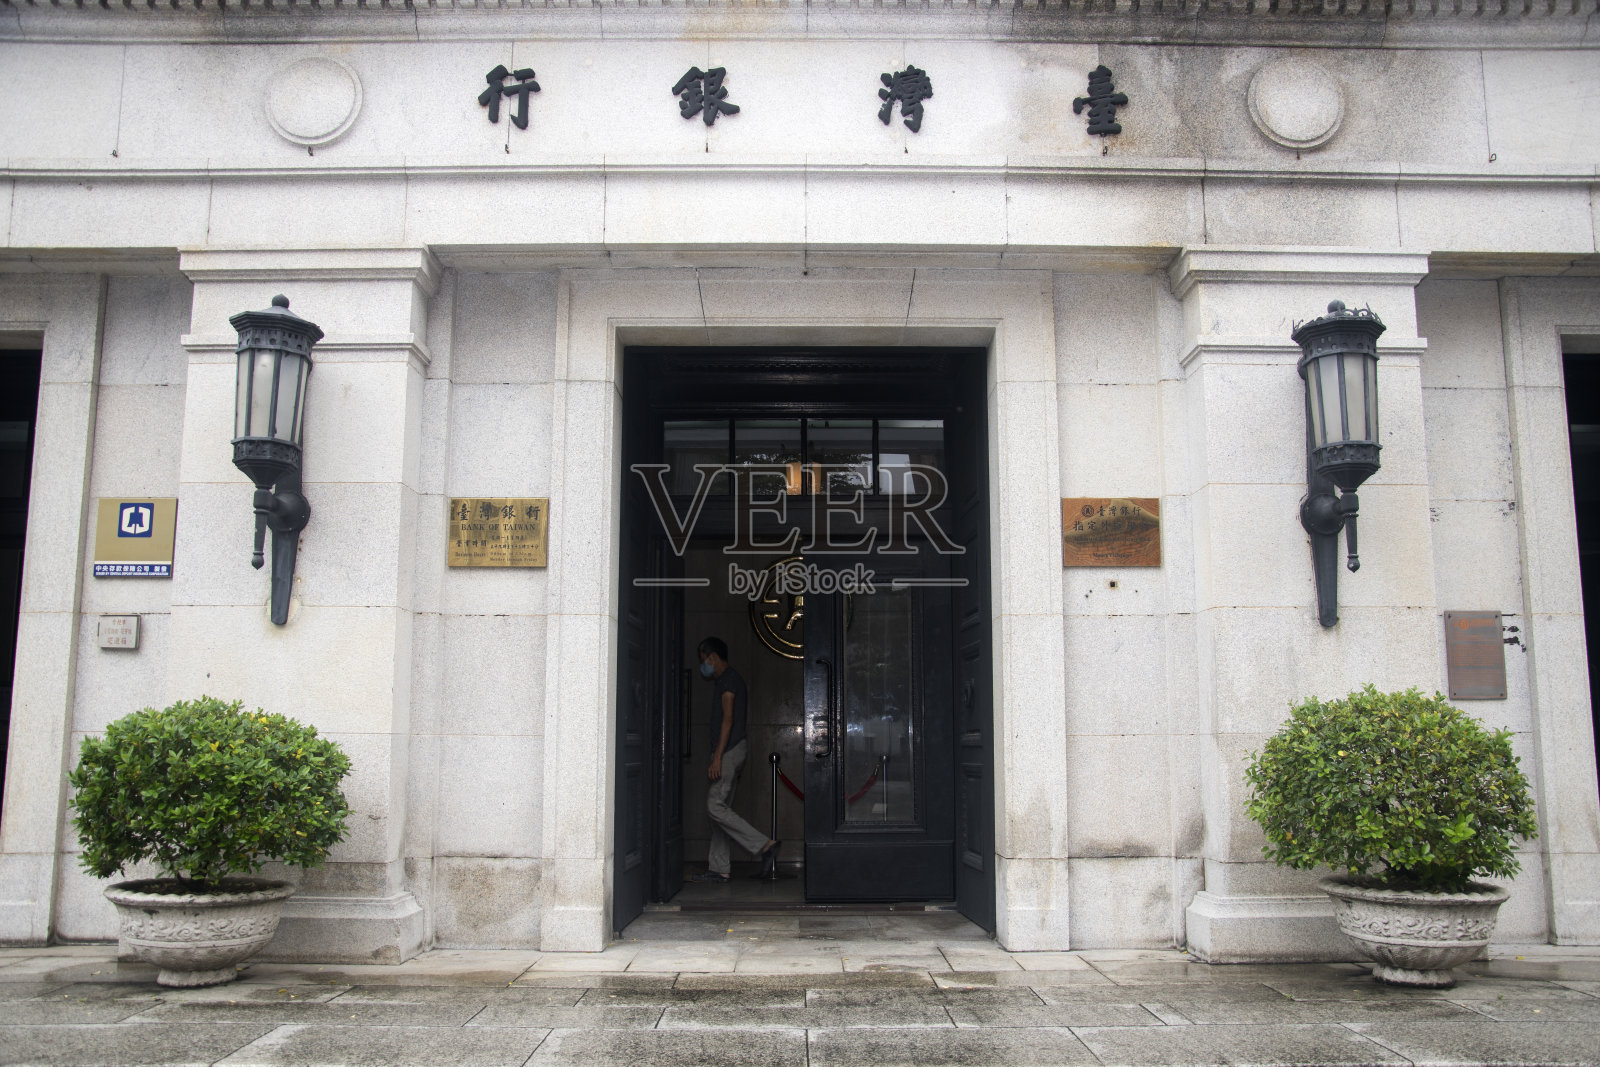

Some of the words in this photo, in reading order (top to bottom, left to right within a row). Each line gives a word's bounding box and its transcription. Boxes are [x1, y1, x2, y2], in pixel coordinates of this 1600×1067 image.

[457, 503, 540, 520] 臺灣銀行
[1097, 505, 1141, 516] 臺灣銀行
[461, 523, 485, 531] BANK
[488, 523, 500, 531] OF
[503, 523, 536, 531] TAIWAN
